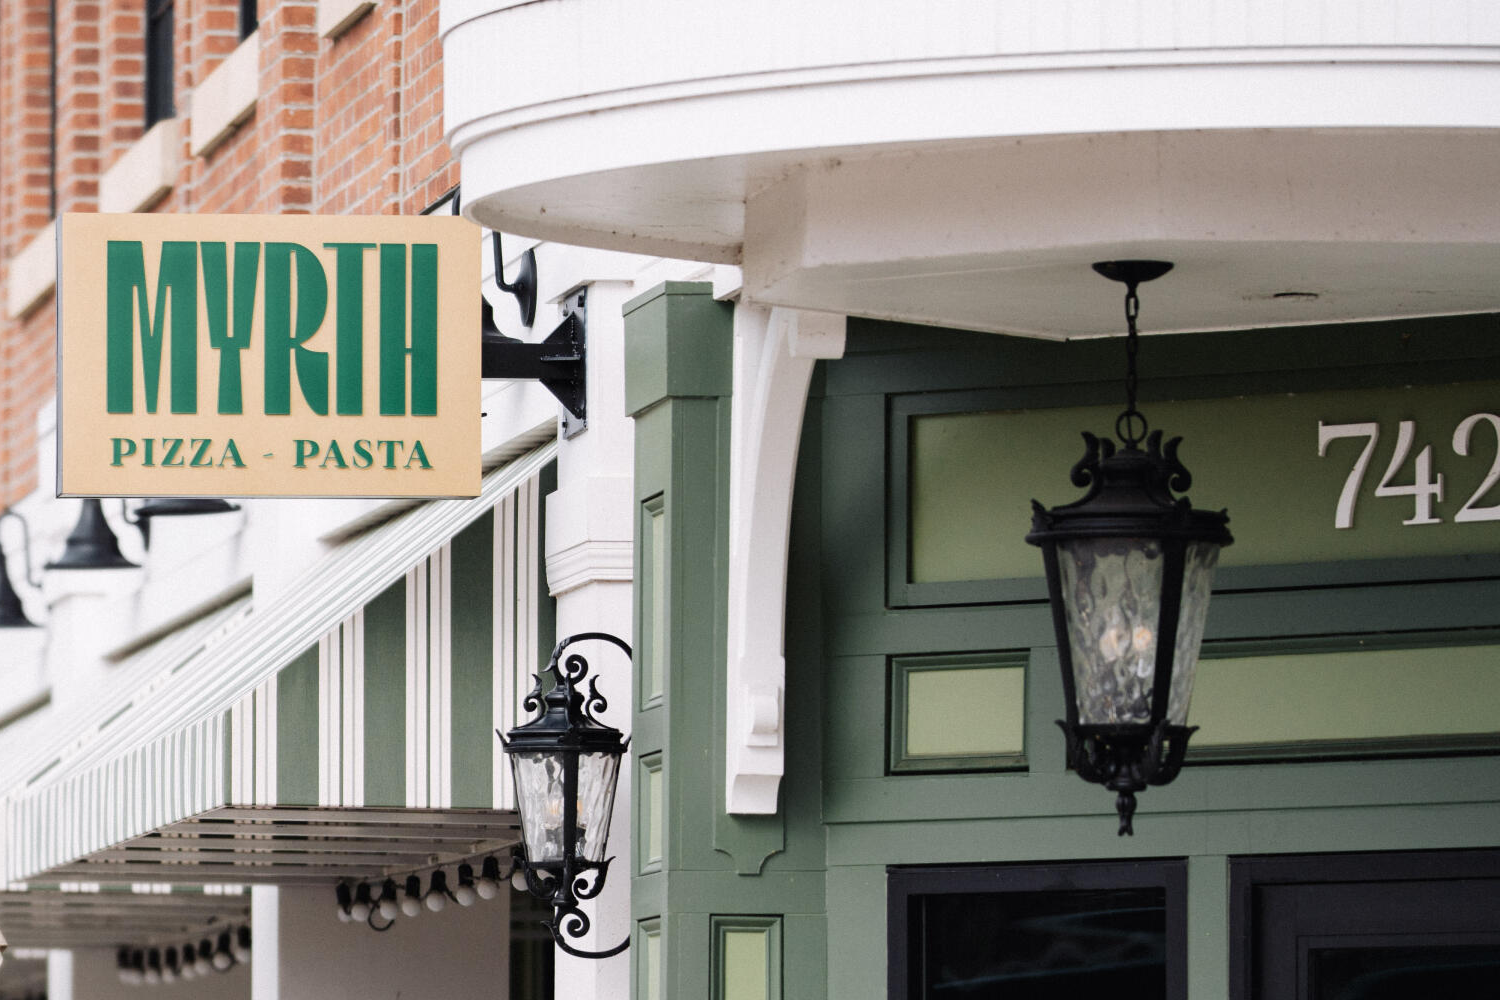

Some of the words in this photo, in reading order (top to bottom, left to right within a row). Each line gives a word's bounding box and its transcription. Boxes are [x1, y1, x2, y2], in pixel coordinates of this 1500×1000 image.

[106, 240, 439, 417] MYRTH
[110, 437, 247, 468] PIZZA
[293, 438, 434, 470] PASTA
[1318, 412, 1500, 529] 742
